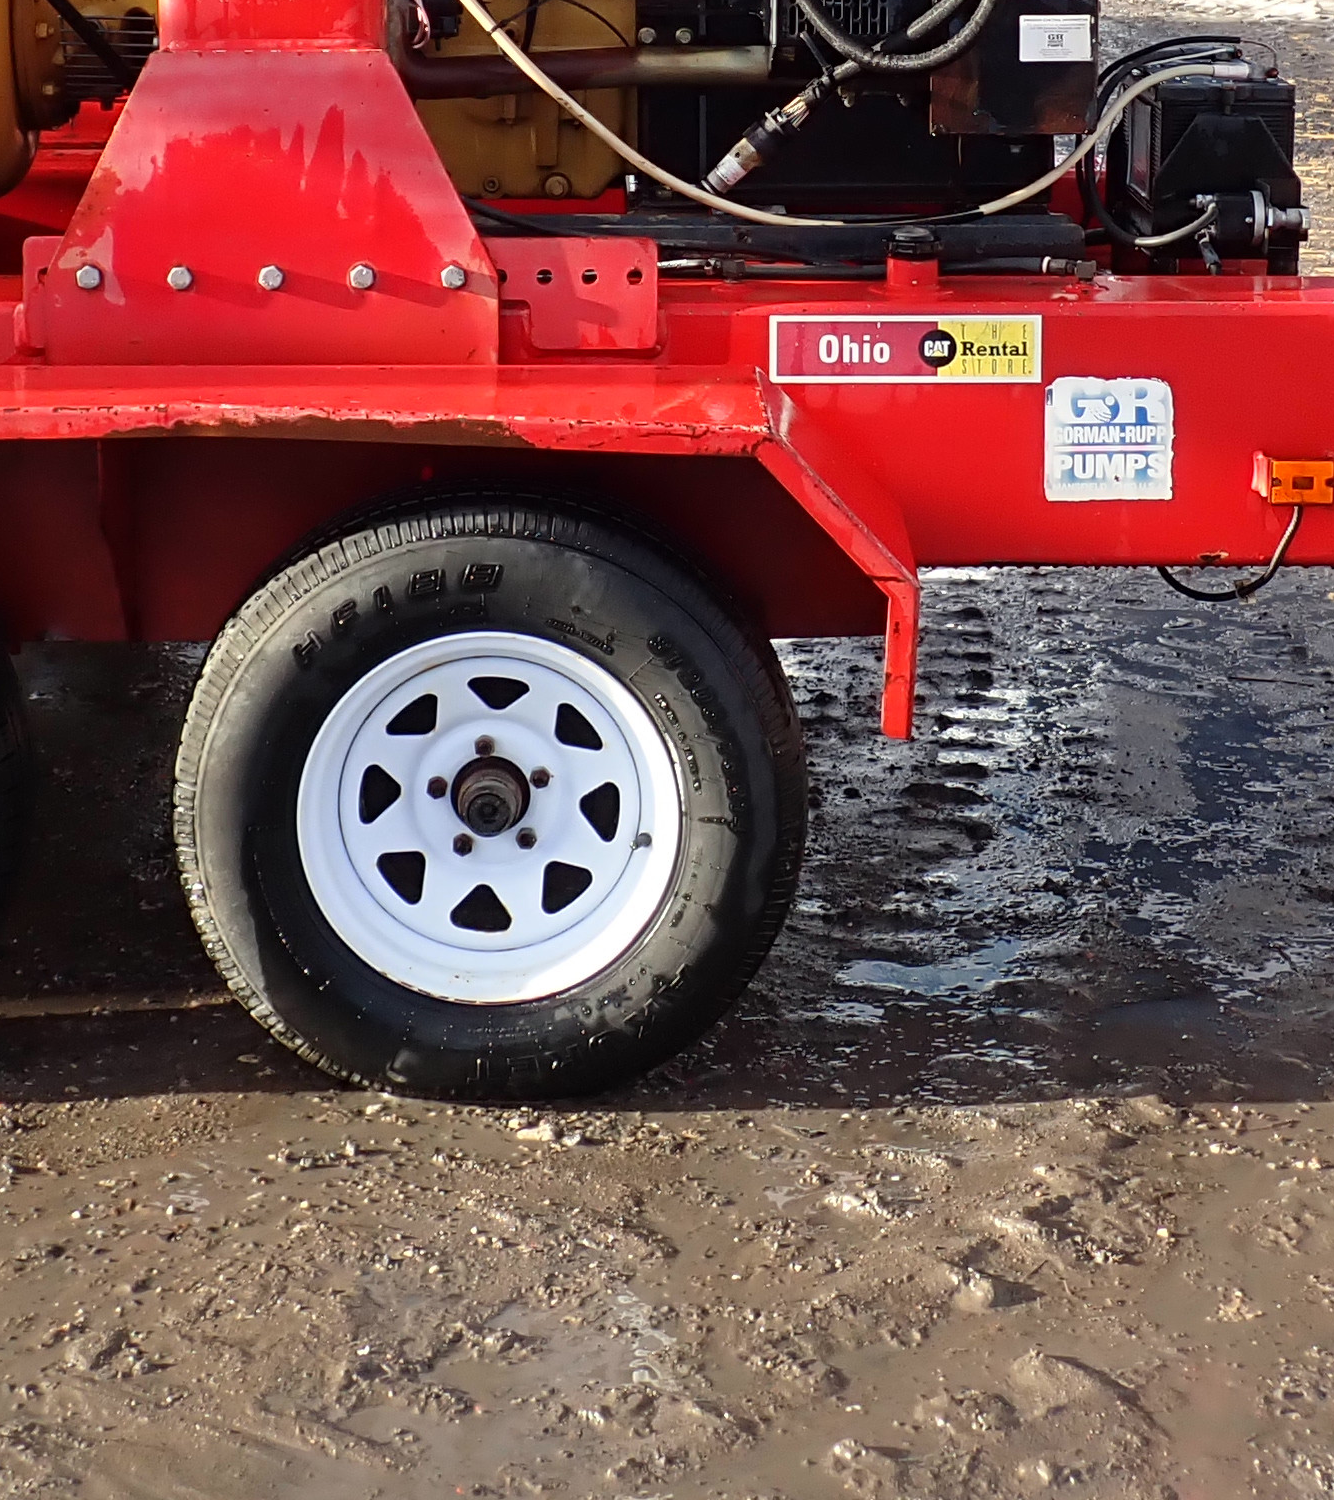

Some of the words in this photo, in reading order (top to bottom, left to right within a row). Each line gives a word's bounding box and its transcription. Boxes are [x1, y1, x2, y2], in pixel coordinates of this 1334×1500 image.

[818, 334, 891, 364] Ohio
[923, 340, 951, 357] CAT
[960, 340, 1028, 357] Rental
[1054, 425, 1167, 444] GORMAN-RUPP
[1054, 453, 1167, 480] PUMPS
